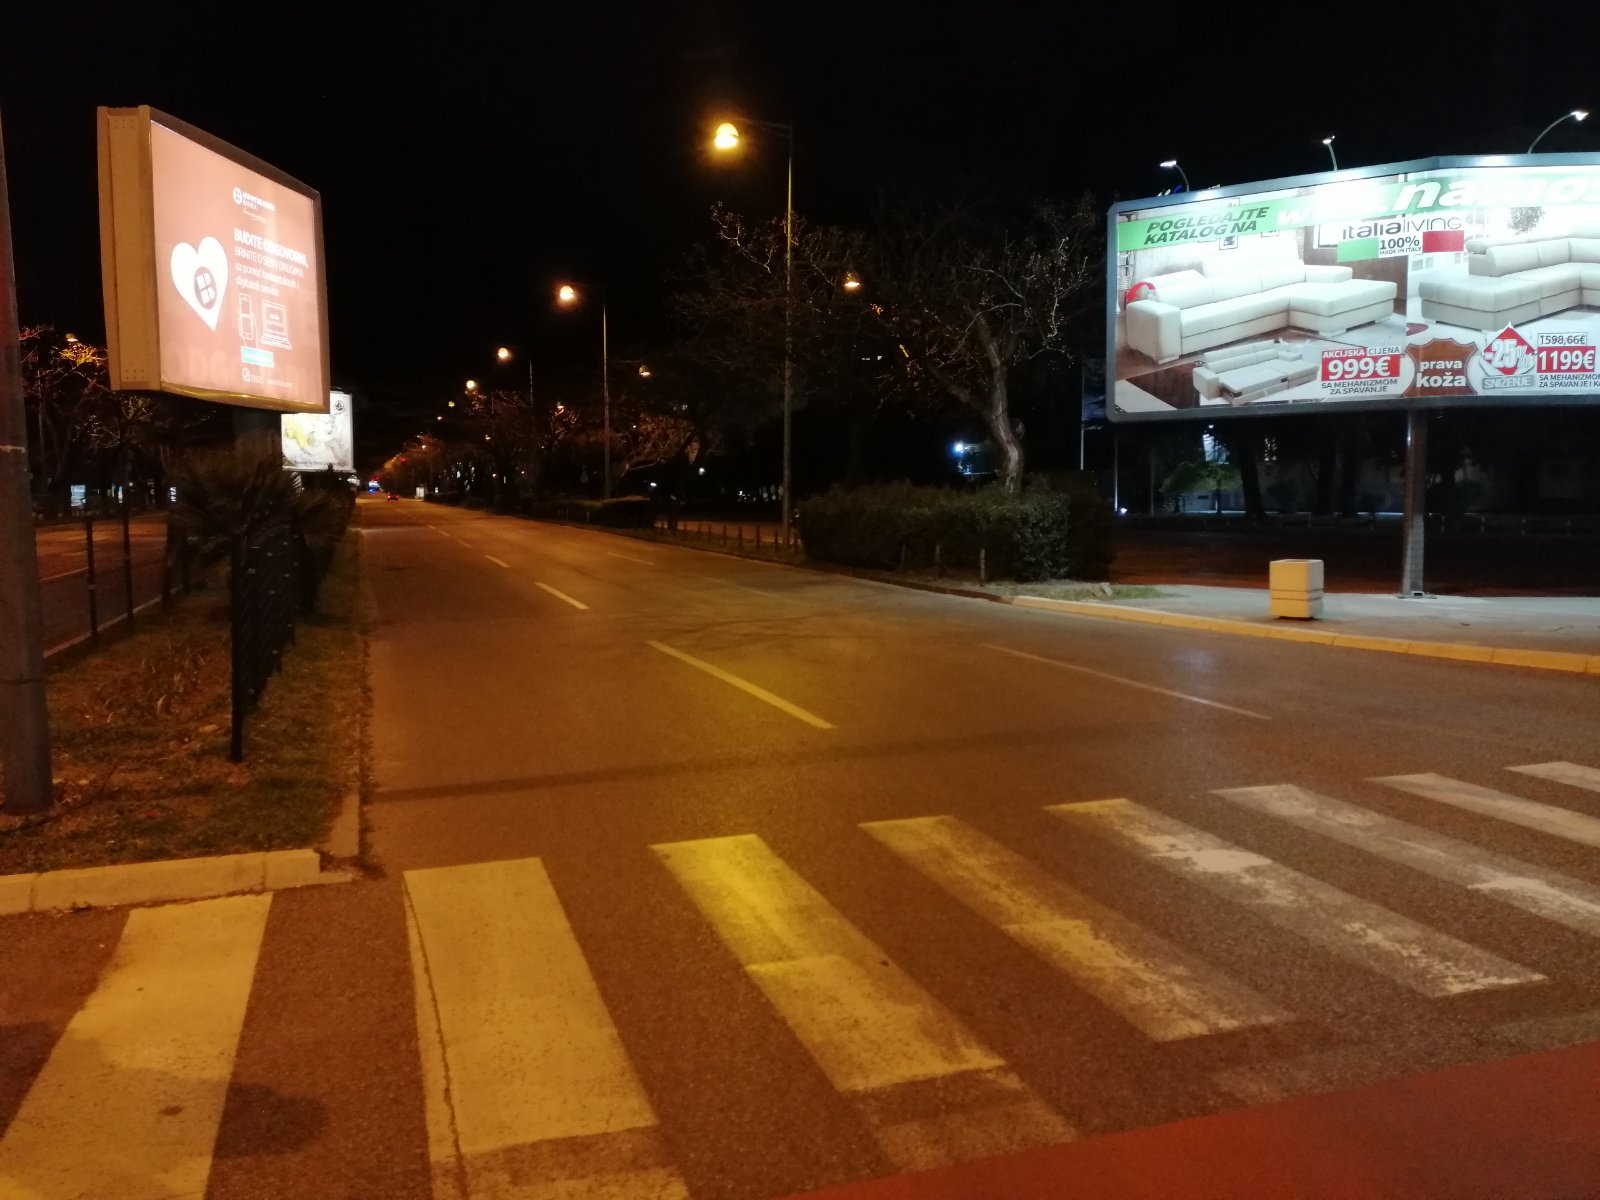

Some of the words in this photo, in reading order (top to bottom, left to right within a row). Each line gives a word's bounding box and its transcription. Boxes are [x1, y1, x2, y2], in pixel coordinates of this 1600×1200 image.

[1147, 207, 1270, 233] POGLEDAJTE
[234, 228, 263, 249] BUDITE
[1144, 223, 1228, 245] KATALOG
[1231, 221, 1257, 233] NA
[1379, 236, 1420, 250] 100%
[234, 245, 257, 262] BRINITE
[1322, 348, 1365, 359] AKCIJSKA
[1367, 346, 1400, 355] CIJENA
[1539, 350, 1595, 370] 1199€
[1328, 356, 1391, 380] 999€
[1420, 360, 1463, 372] prava
[1333, 378, 1398, 388] MEHANIZMOM
[1416, 371, 1467, 388] koža
[1550, 380, 1588, 388] SPAVANJE
[1343, 386, 1388, 395] SPAVANJE
